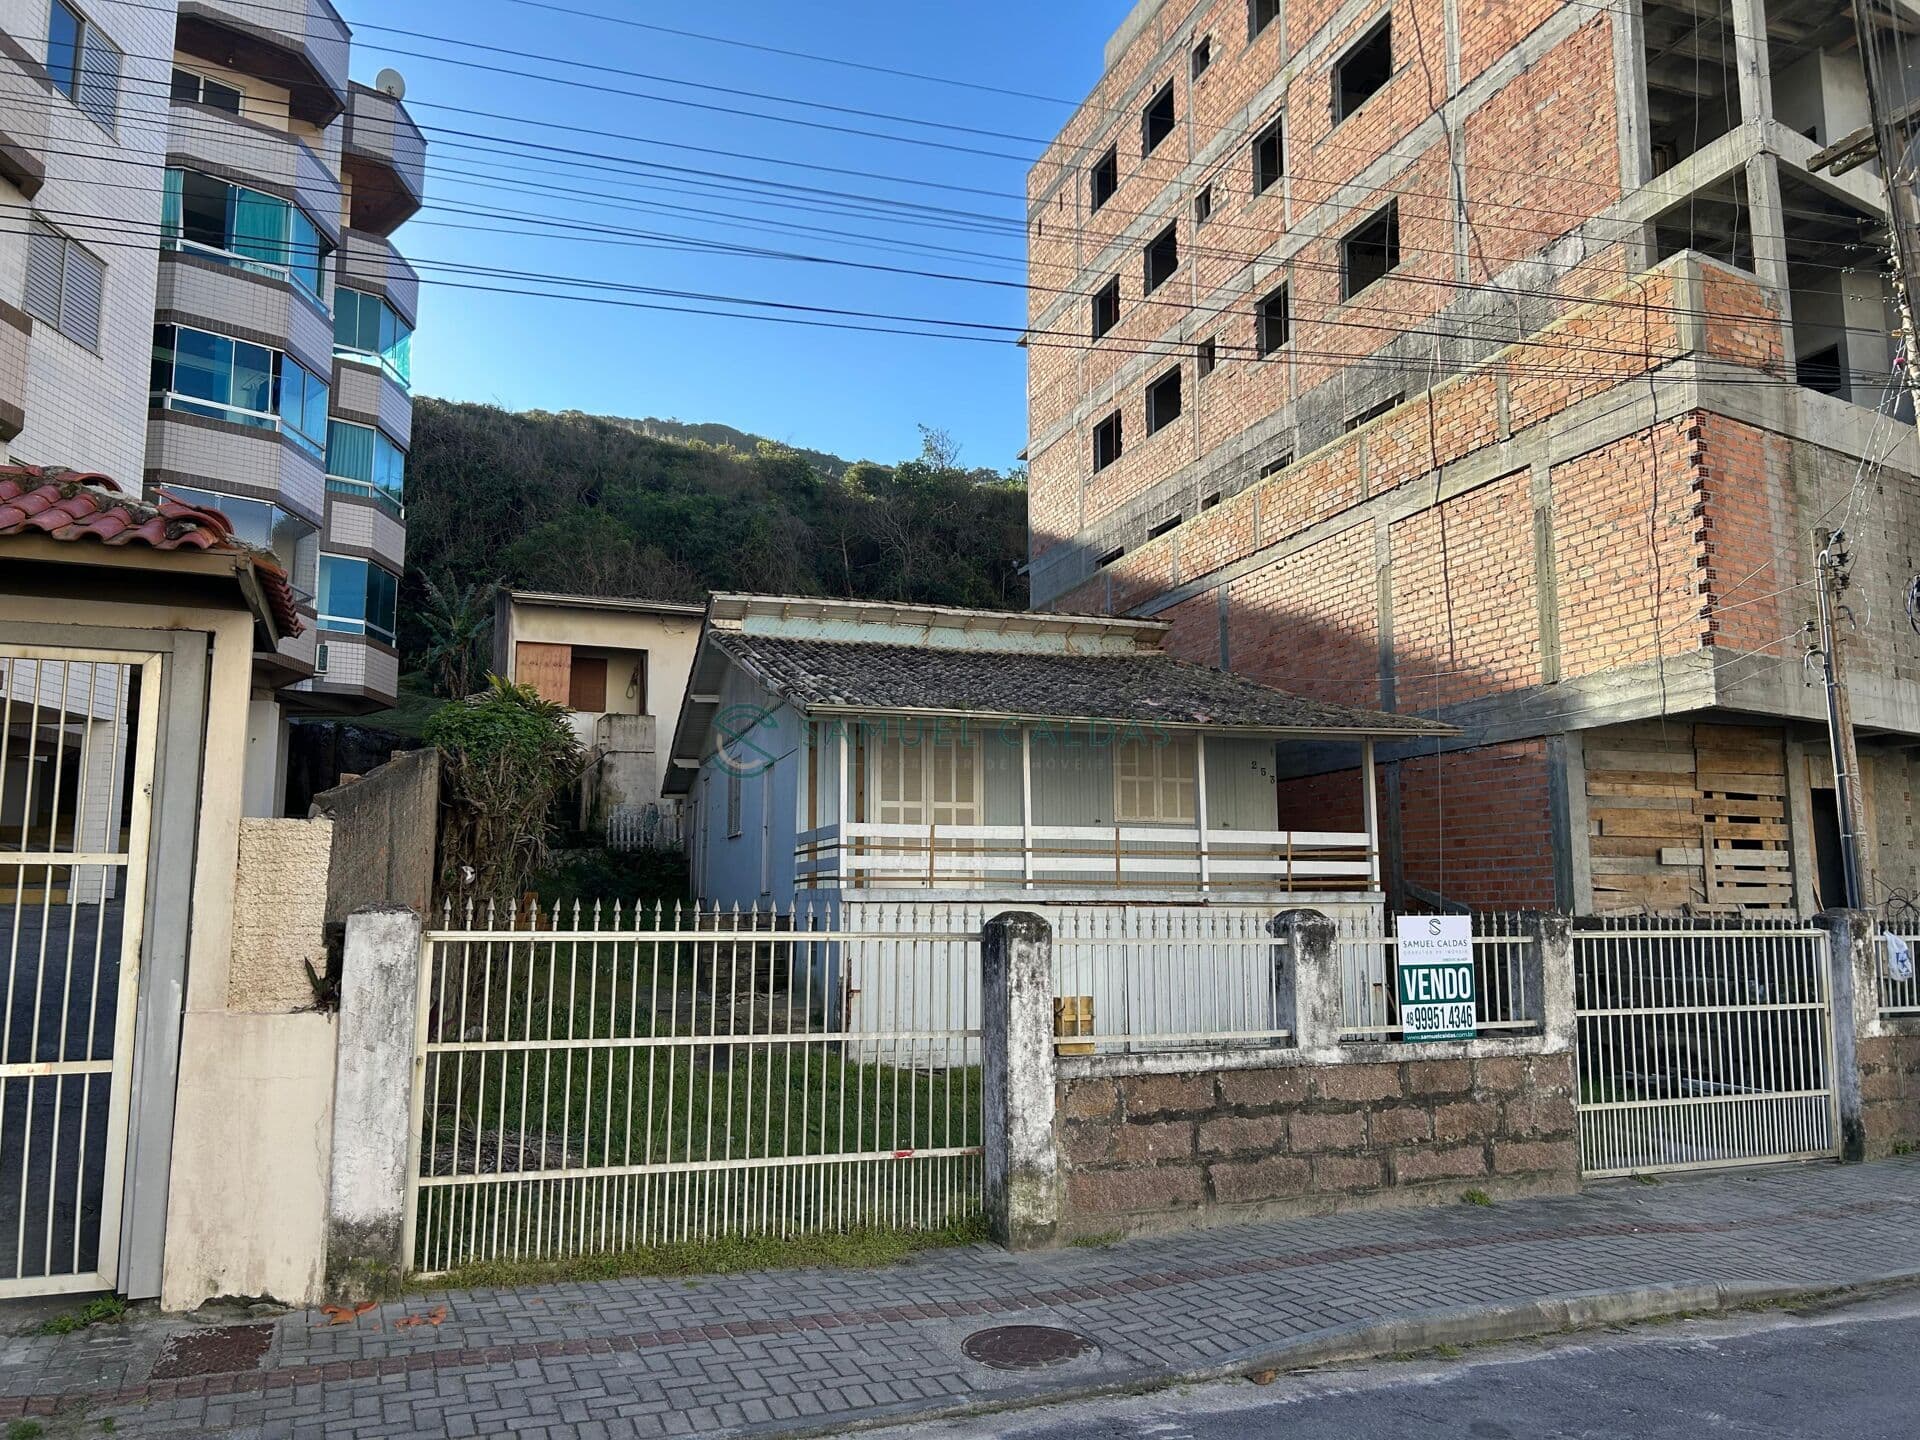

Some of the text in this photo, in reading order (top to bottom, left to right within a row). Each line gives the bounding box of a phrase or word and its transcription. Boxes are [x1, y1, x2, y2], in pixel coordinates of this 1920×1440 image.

[1248, 760, 1276, 785] 253
[1403, 939, 1468, 948] SAMUEL CALDAS
[1404, 967, 1471, 1000] VENDO
[1415, 1005, 1472, 1030] 99951.4346
